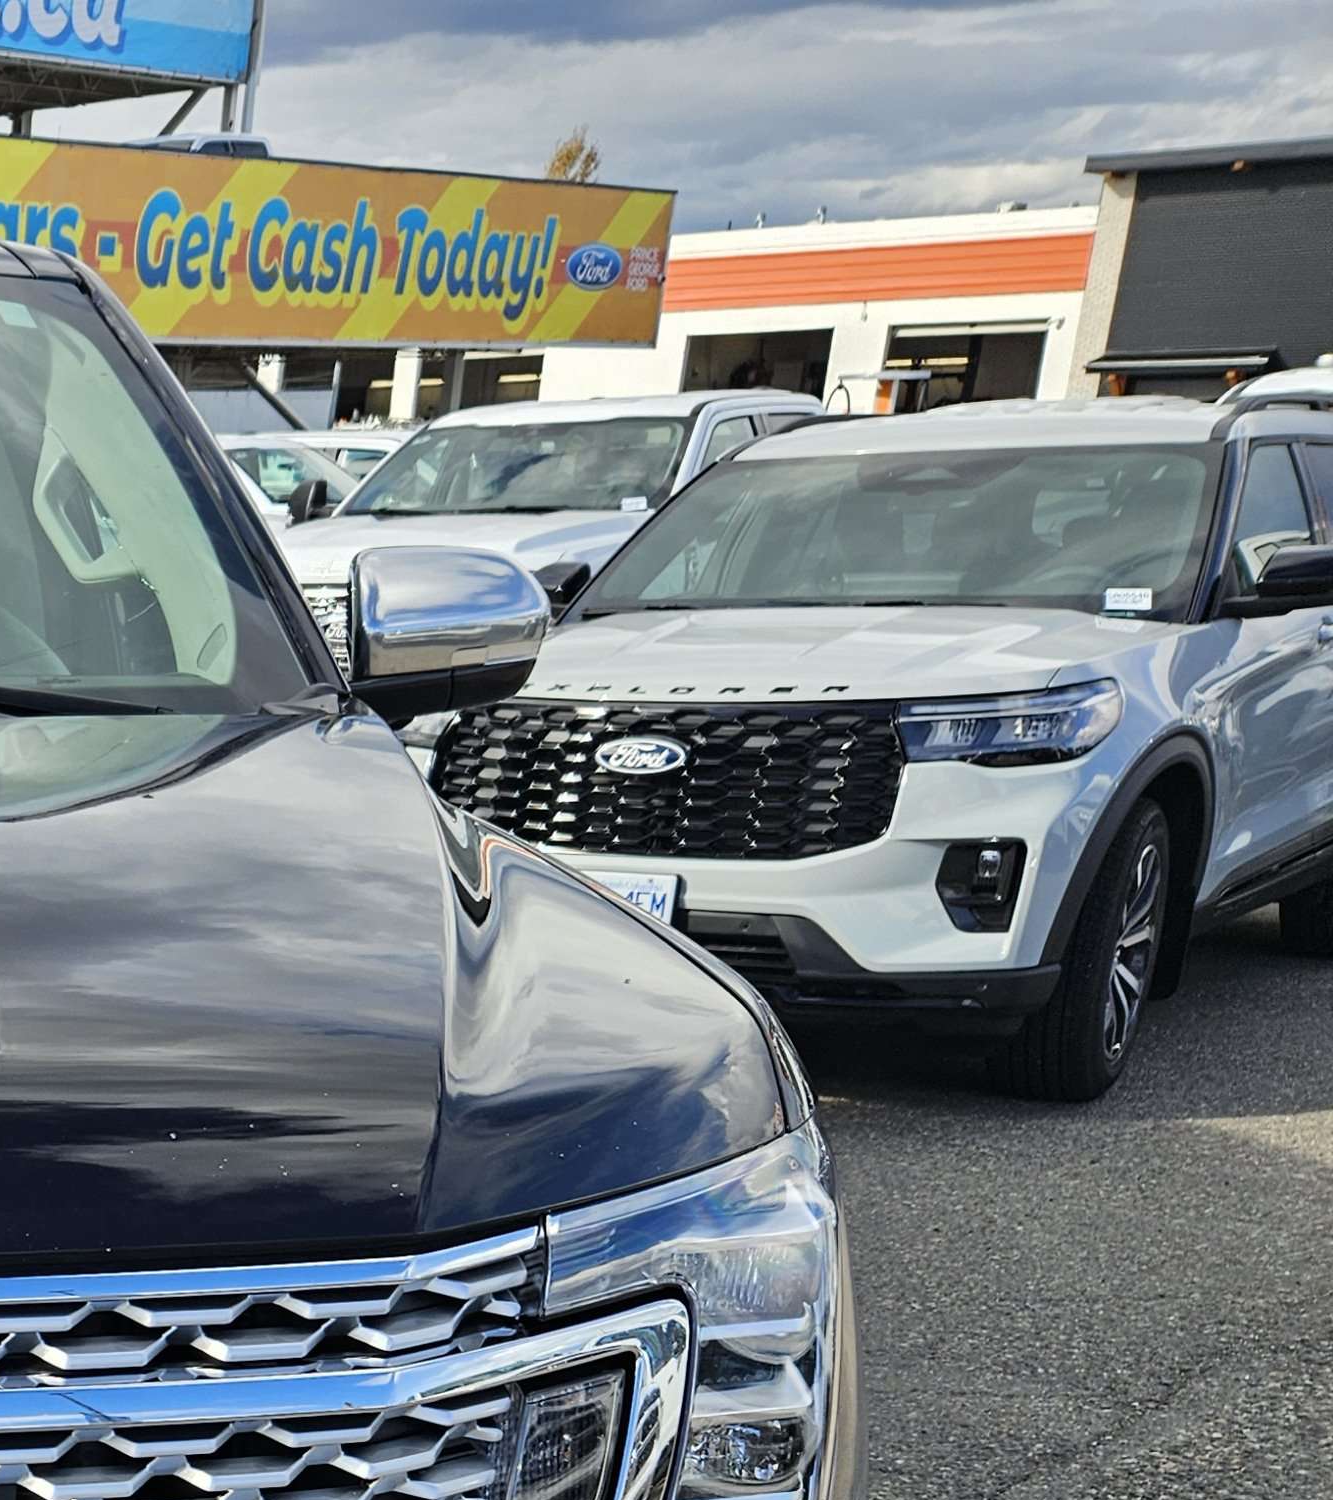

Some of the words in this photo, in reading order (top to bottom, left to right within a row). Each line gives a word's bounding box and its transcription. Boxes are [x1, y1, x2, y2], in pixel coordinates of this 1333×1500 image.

[135, 188, 235, 291] Get
[247, 196, 379, 295] Cash
[394, 206, 559, 322] Today!
[576, 250, 613, 282] Ford
[609, 743, 670, 768] Ford
